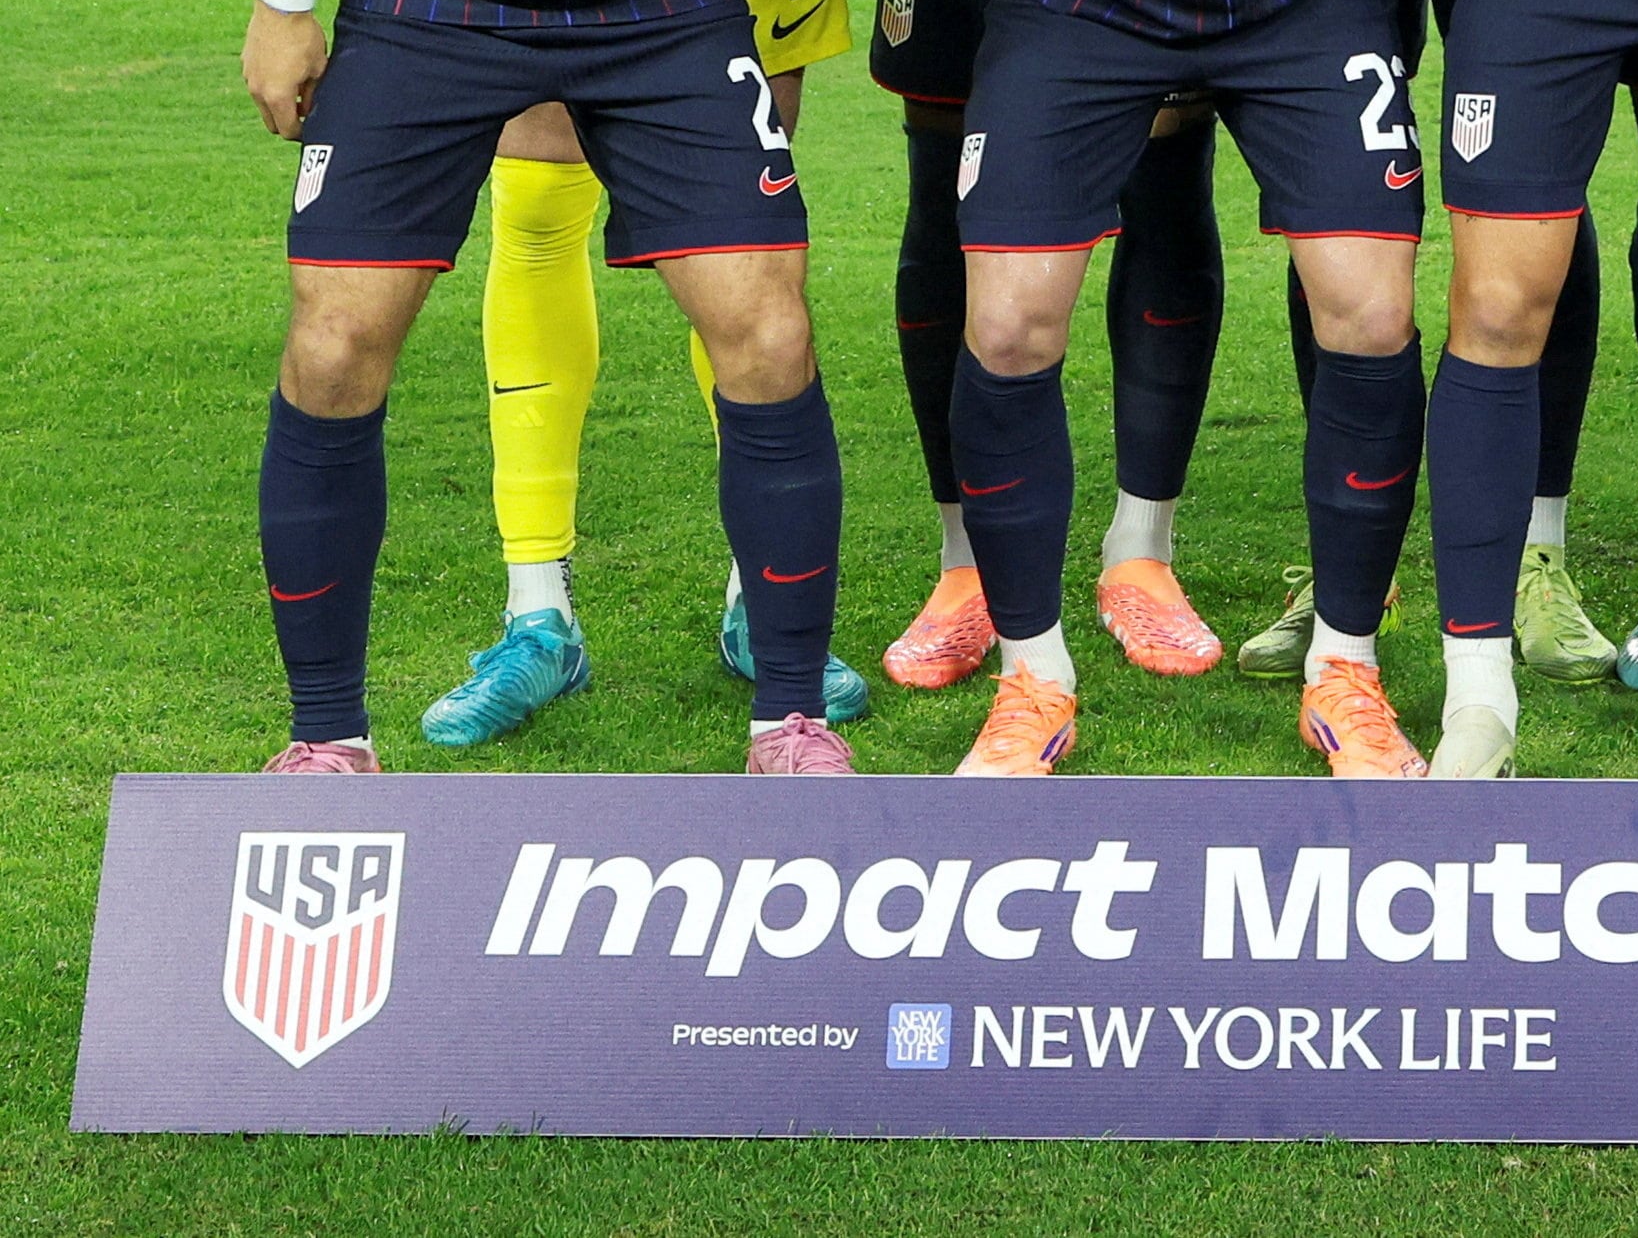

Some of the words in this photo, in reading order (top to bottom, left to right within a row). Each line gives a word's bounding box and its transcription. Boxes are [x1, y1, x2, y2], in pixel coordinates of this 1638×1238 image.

[727, 56, 789, 150] 2
[1343, 53, 1419, 151] 2
[1457, 98, 1491, 122] USA
[245, 843, 394, 929] USA
[485, 840, 1158, 977] Impact
[672, 1024, 817, 1047] Presented
[824, 1024, 859, 1050] by
[892, 1026, 945, 1046] YORK
[899, 1011, 942, 1029] NEW
[969, 1004, 1156, 1070] NEW
[1167, 1006, 1382, 1071] YORK
[1399, 1008, 1558, 1072] LIFE
[897, 1044, 938, 1062] LIFE
